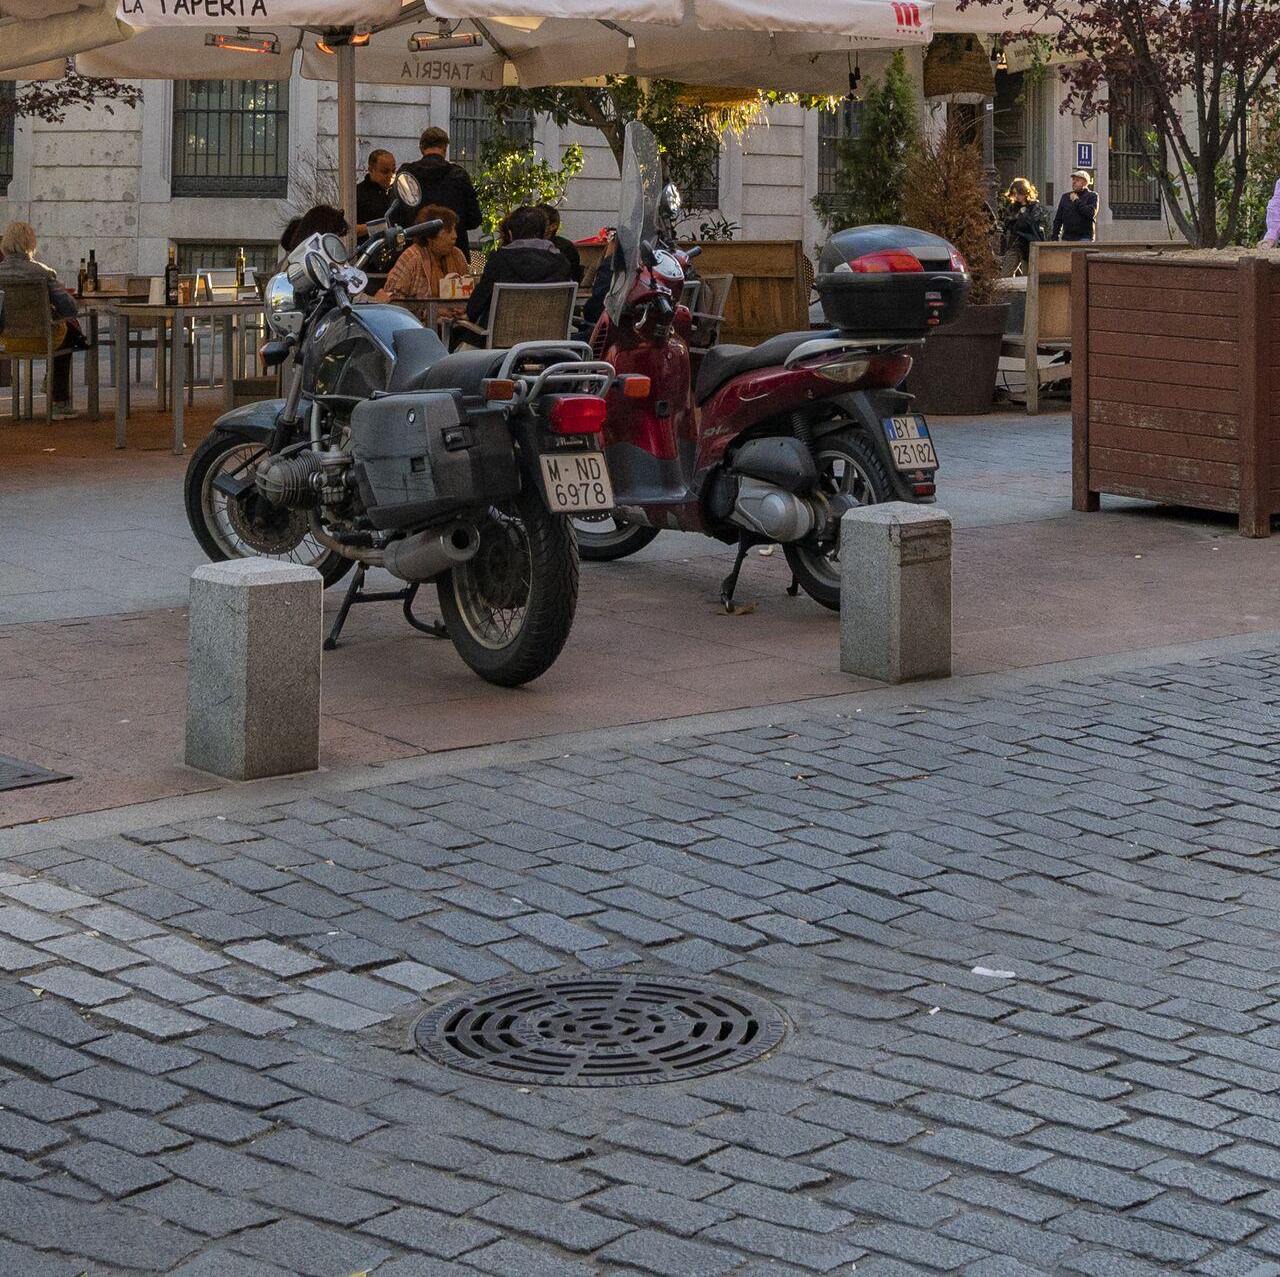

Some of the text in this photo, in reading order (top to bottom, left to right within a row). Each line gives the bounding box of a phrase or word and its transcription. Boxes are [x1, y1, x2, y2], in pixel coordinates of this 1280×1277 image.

[894, 419, 910, 438] BY
[893, 443, 935, 465] 23182
[555, 482, 607, 506] 6978
